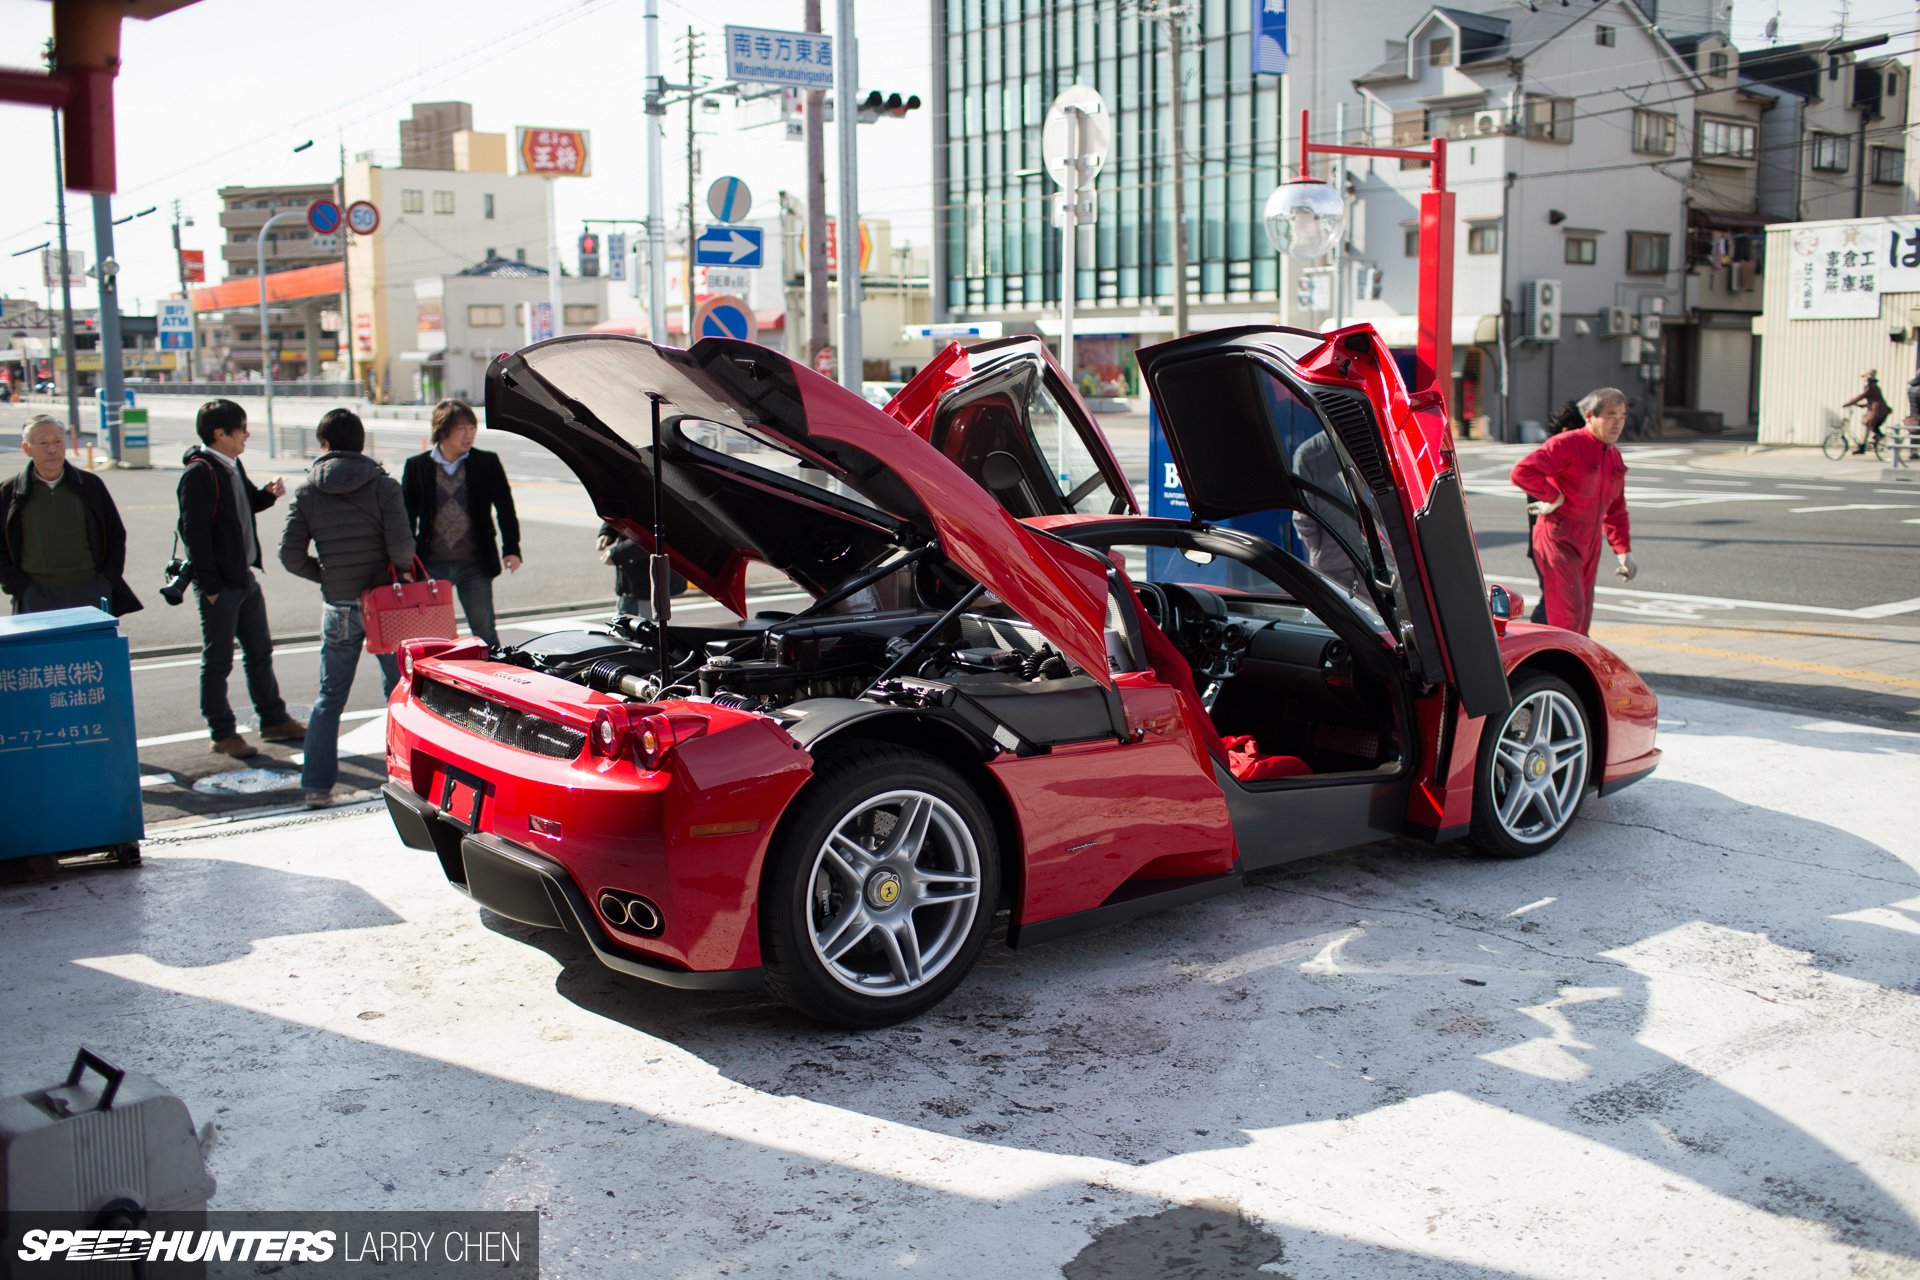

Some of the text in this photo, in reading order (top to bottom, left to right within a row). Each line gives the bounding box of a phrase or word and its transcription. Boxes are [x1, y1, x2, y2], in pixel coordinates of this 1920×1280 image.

[734, 33, 832, 65] 南寺方東通
[533, 145, 577, 170] 王将
[352, 209, 373, 226] 50
[1841, 249, 1859, 293] 倉庫
[1859, 250, 1876, 292] 工場
[162, 316, 188, 327] ATM
